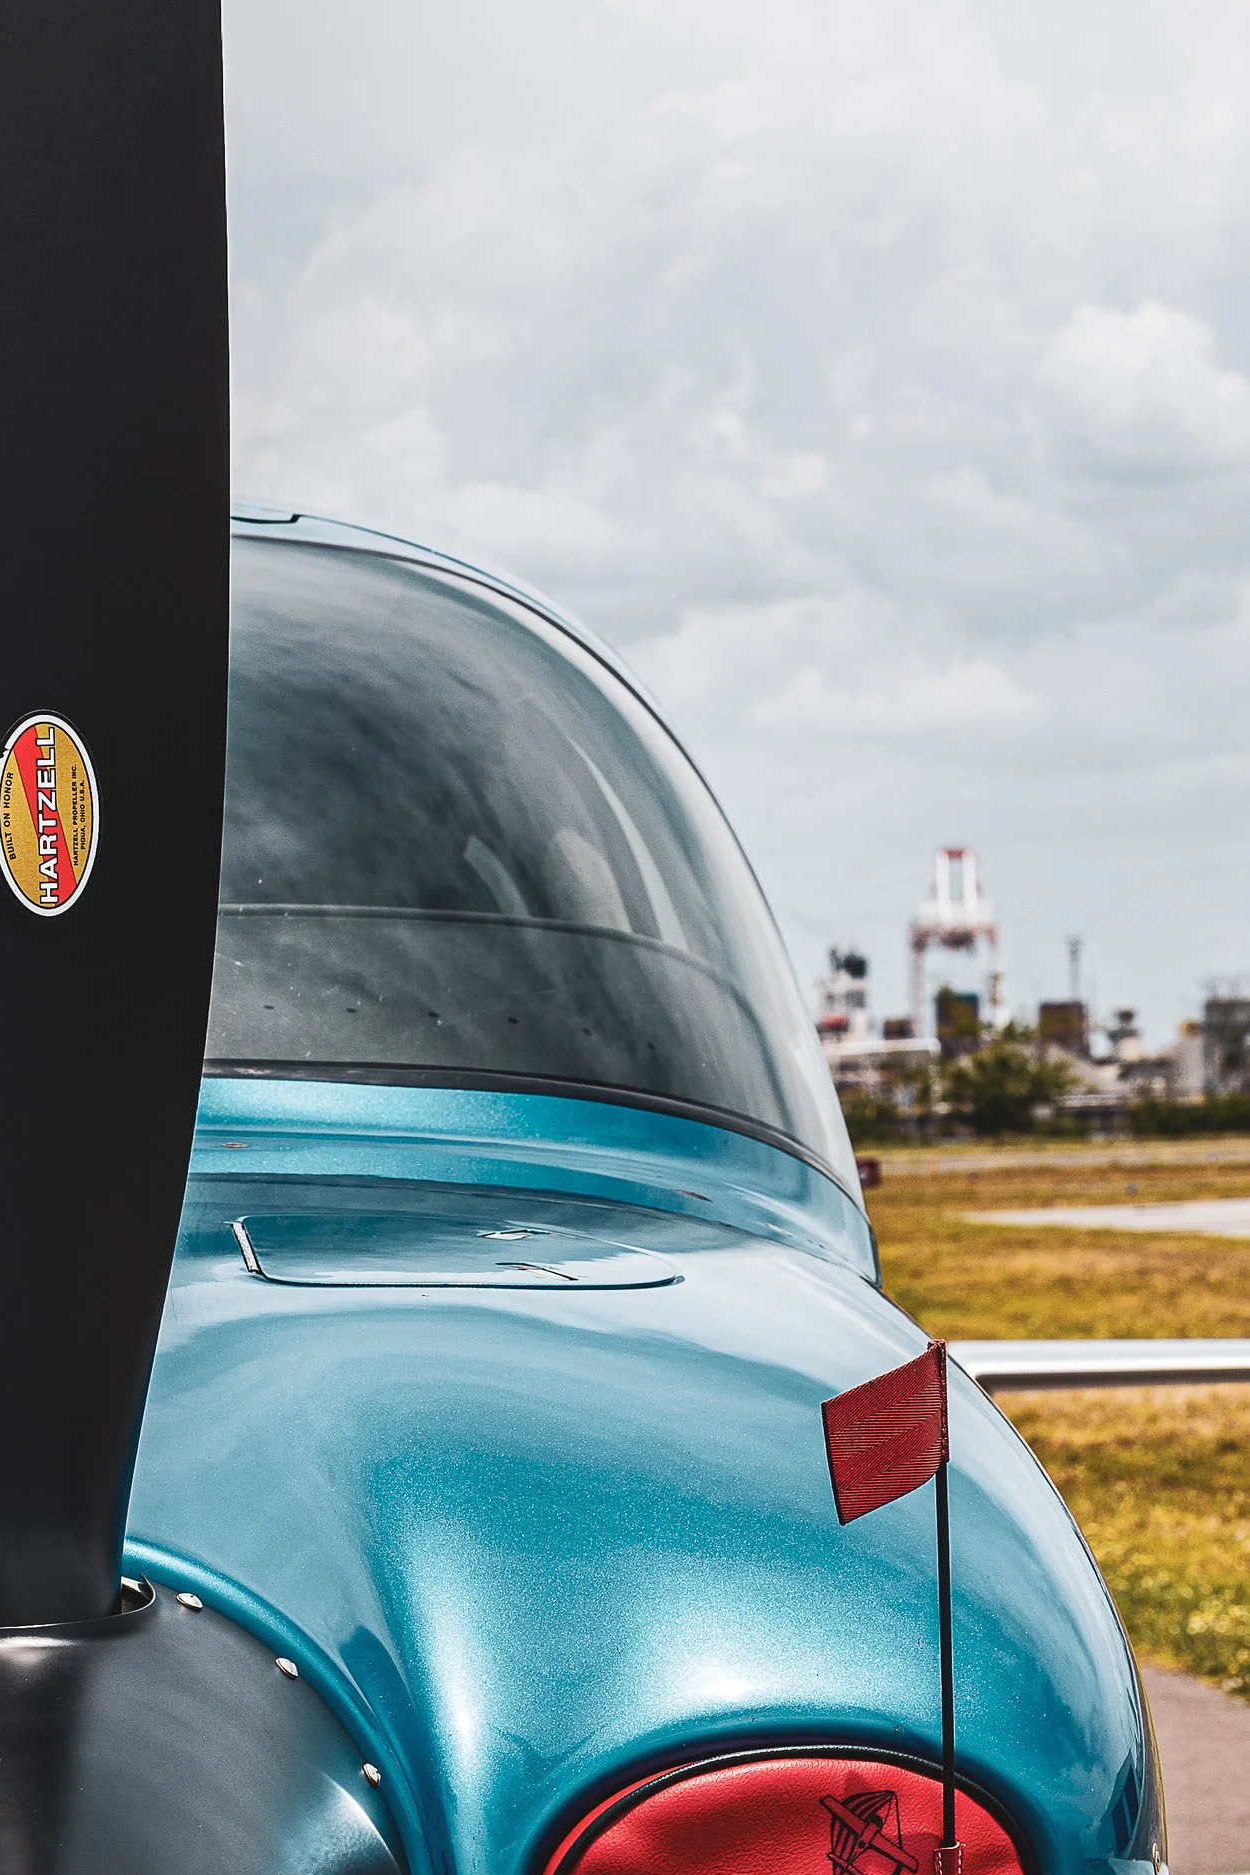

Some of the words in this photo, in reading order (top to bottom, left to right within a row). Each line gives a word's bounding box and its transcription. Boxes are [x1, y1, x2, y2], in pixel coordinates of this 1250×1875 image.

[3, 771, 14, 808] HONOR
[3, 812, 11, 828] ON
[36, 727, 58, 904] HARTZELL
[4, 832, 16, 860] BUILT
